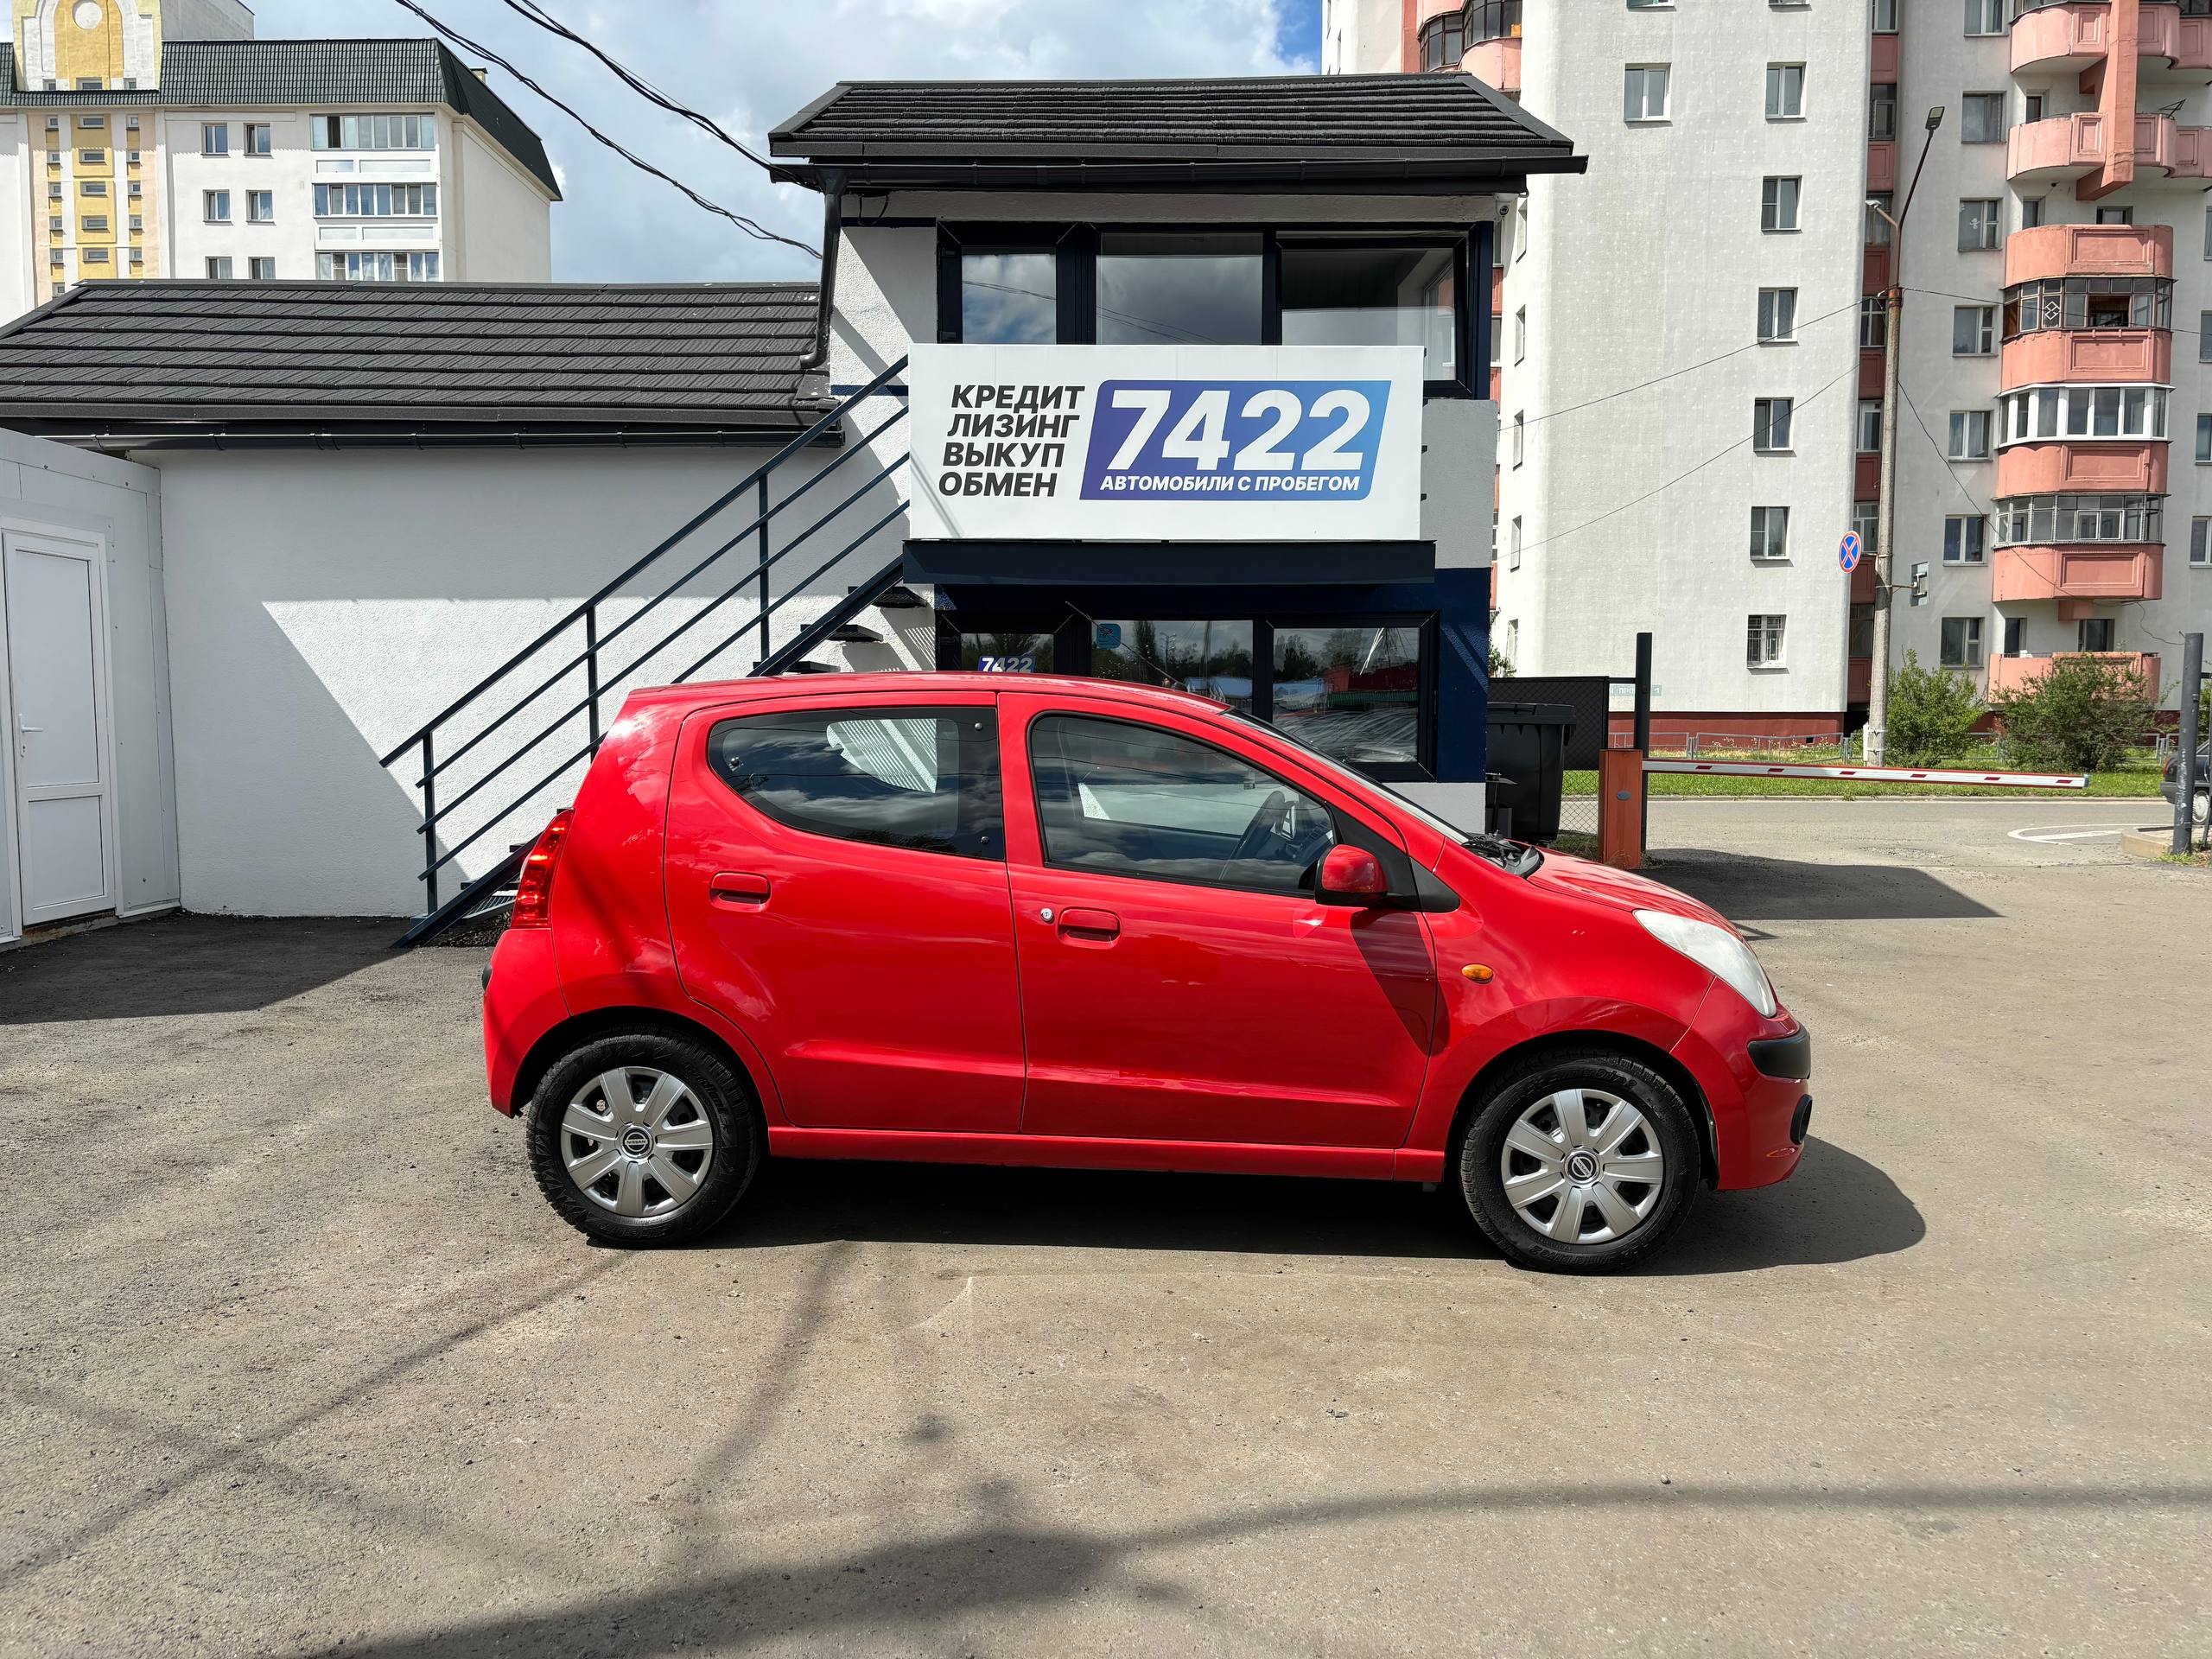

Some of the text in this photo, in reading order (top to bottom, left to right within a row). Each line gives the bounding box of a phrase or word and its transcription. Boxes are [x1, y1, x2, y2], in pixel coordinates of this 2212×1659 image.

[951, 385, 1085, 414] КРЕДИТ
[947, 413, 1080, 438] ЛИЗИНГ
[1106, 389, 1371, 471] 7422
[943, 442, 1065, 467] ВЫКУП
[938, 471, 1058, 498] ОБМЕН
[1099, 475, 1361, 492] АВТОМОБИЛИ С ПРОБЕГОМ
[982, 657, 1033, 673] 7422
